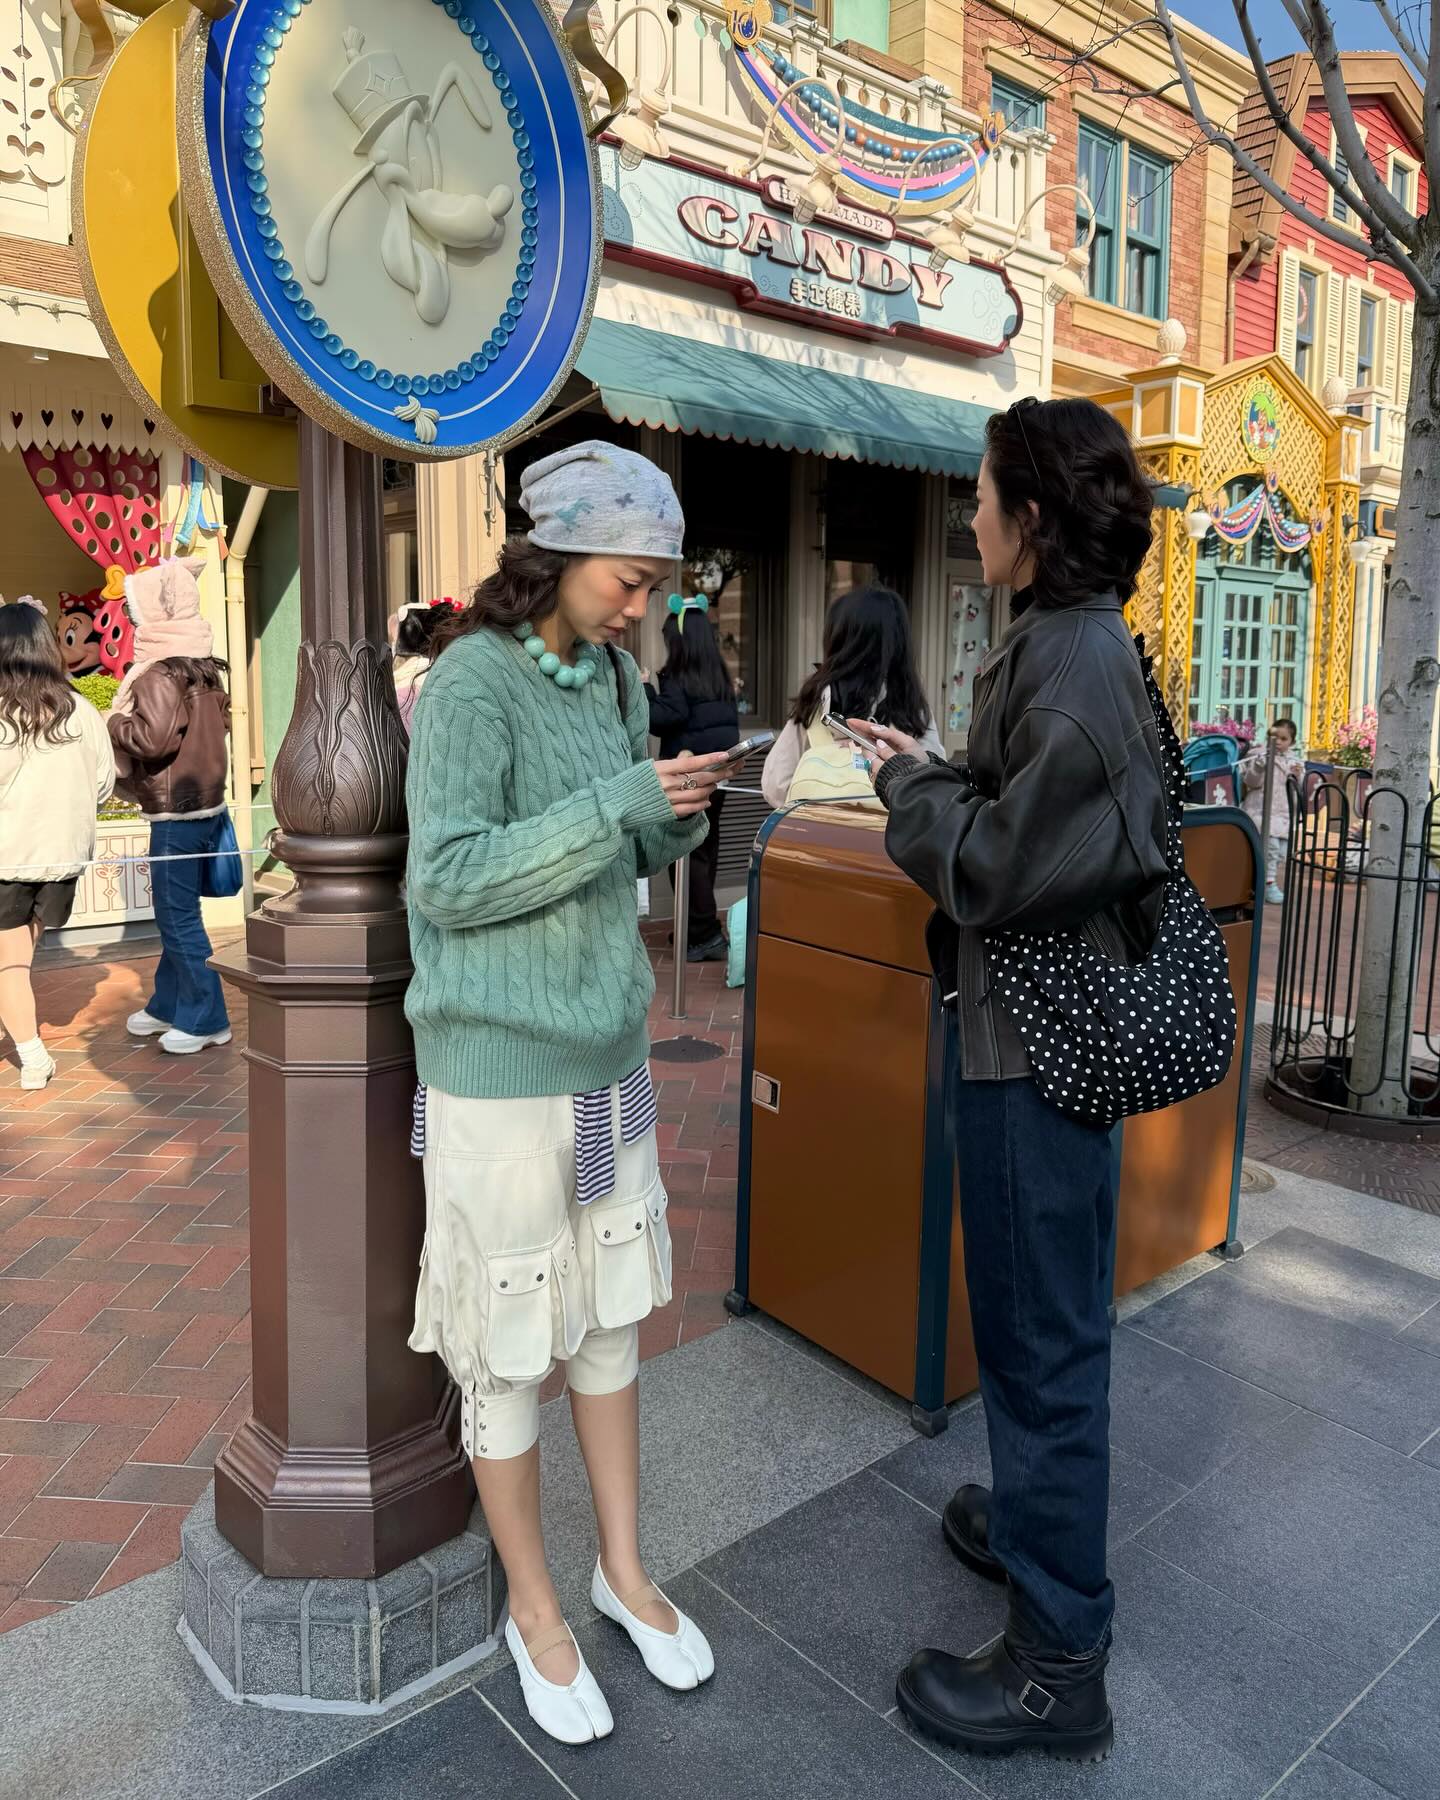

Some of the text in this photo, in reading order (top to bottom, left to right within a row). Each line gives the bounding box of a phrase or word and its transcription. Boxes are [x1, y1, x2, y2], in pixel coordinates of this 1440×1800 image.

[677, 195, 954, 311] CANDY
[789, 278, 861, 318] 手工糖果
